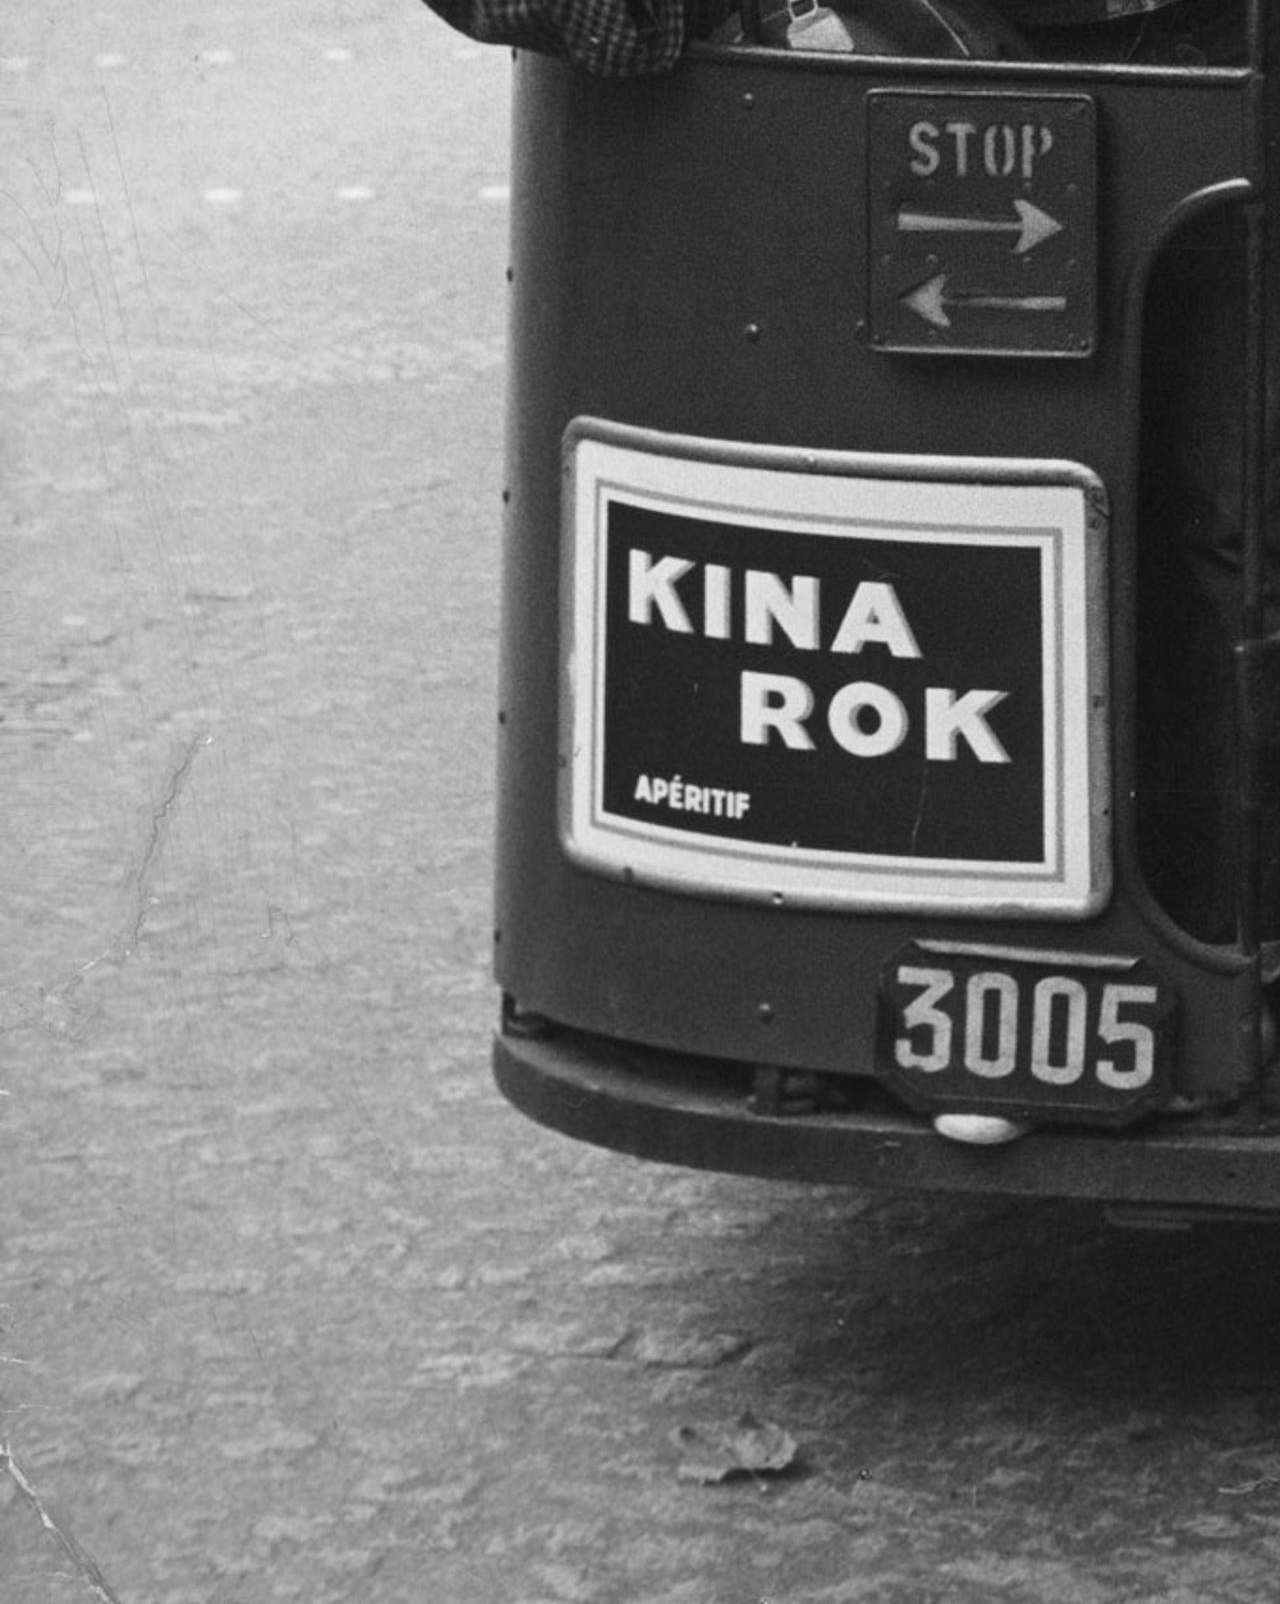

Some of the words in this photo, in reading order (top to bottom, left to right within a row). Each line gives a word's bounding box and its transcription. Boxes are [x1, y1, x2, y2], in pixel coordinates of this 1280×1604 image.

[909, 121, 1054, 178] STOP
[628, 548, 922, 659] KINA
[740, 671, 1011, 763] ROK
[634, 774, 751, 819] APÉRITIF
[895, 966, 1158, 1089] 3005
